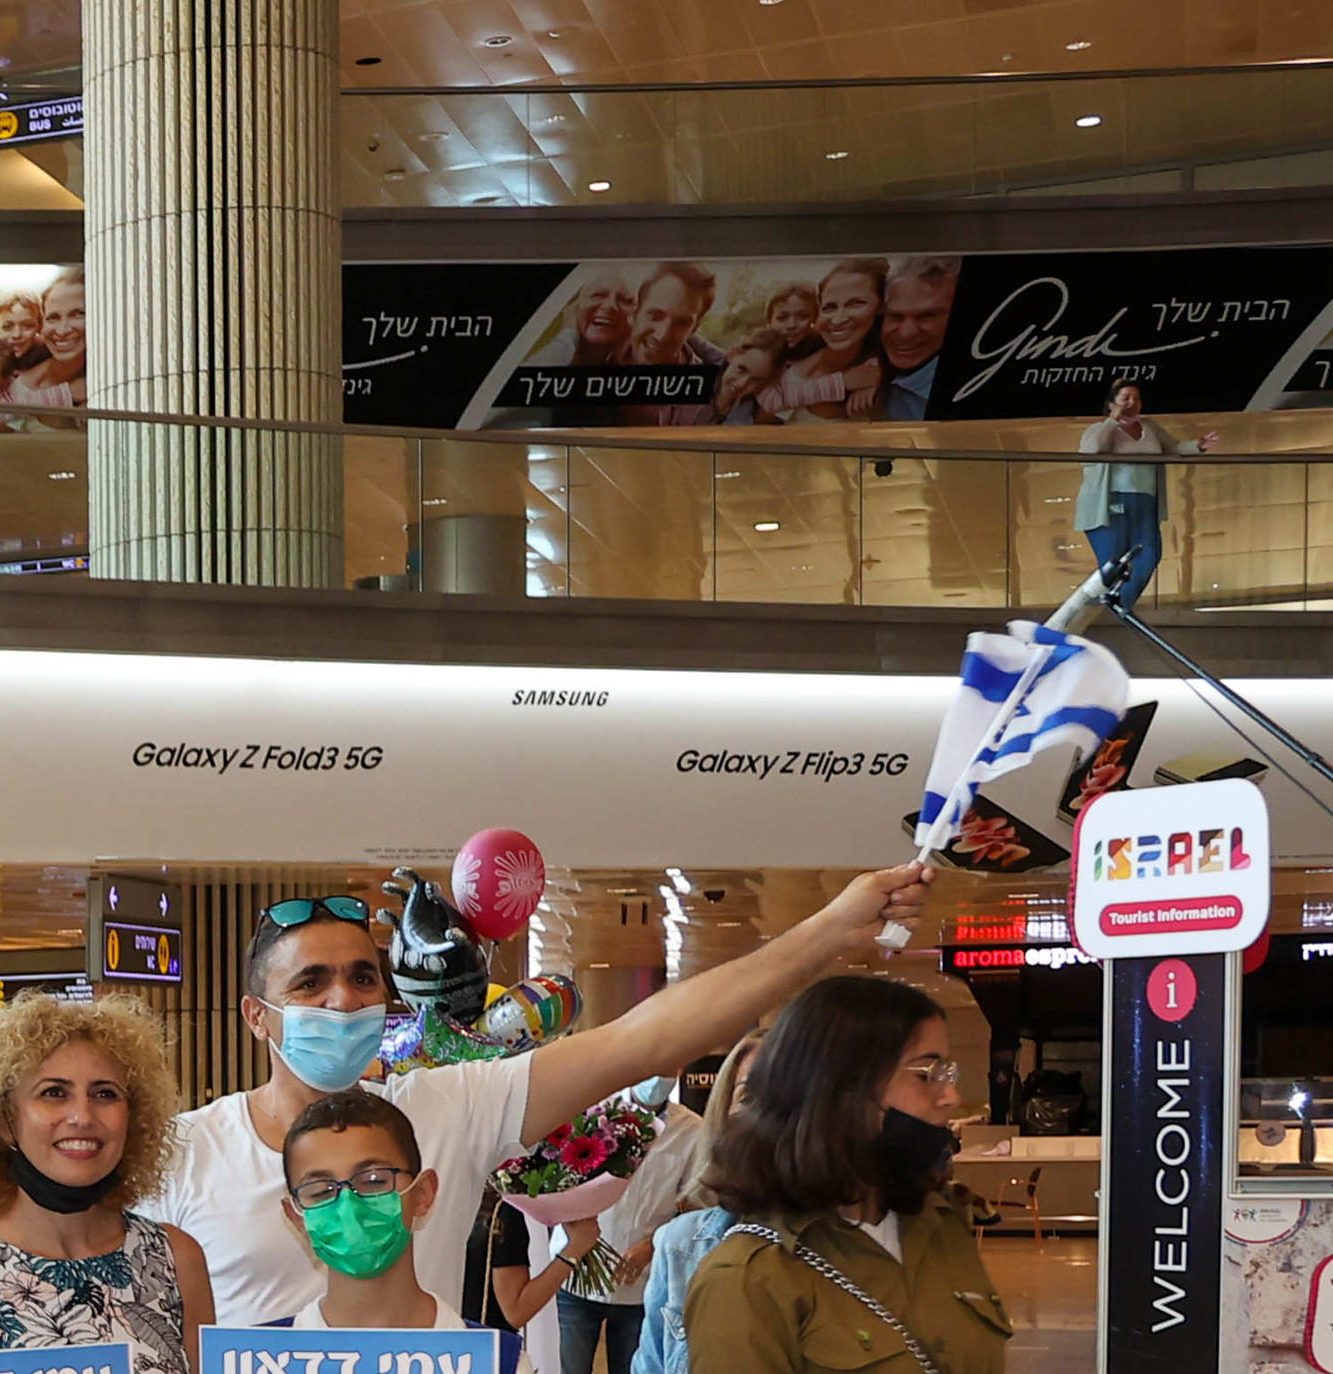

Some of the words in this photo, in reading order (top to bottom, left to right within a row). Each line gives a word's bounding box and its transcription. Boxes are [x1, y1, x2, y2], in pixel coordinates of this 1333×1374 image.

[29, 102, 83, 119] וטובוסים
[29, 119, 51, 131] BUS
[1151, 297, 1211, 332] שלך
[1217, 299, 1291, 323] הבית
[362, 311, 418, 346] שלך
[427, 315, 493, 338] הבית
[519, 371, 576, 405] שלך
[585, 374, 705, 397] השורשים
[1021, 365, 1106, 389] החזקות
[511, 689, 610, 707] SAMSUNG
[132, 742, 238, 775] Galaxy
[239, 745, 260, 769] Z
[262, 745, 338, 771] Fold3
[343, 746, 384, 770] 5G
[676, 749, 780, 780] Galaxy
[780, 751, 801, 774] Z
[800, 750, 865, 783] Flip3
[868, 753, 910, 776] 5G
[1109, 910, 1155, 925] Tourist
[1157, 905, 1236, 922] Information
[1151, 1039, 1191, 1333] WELCOME
